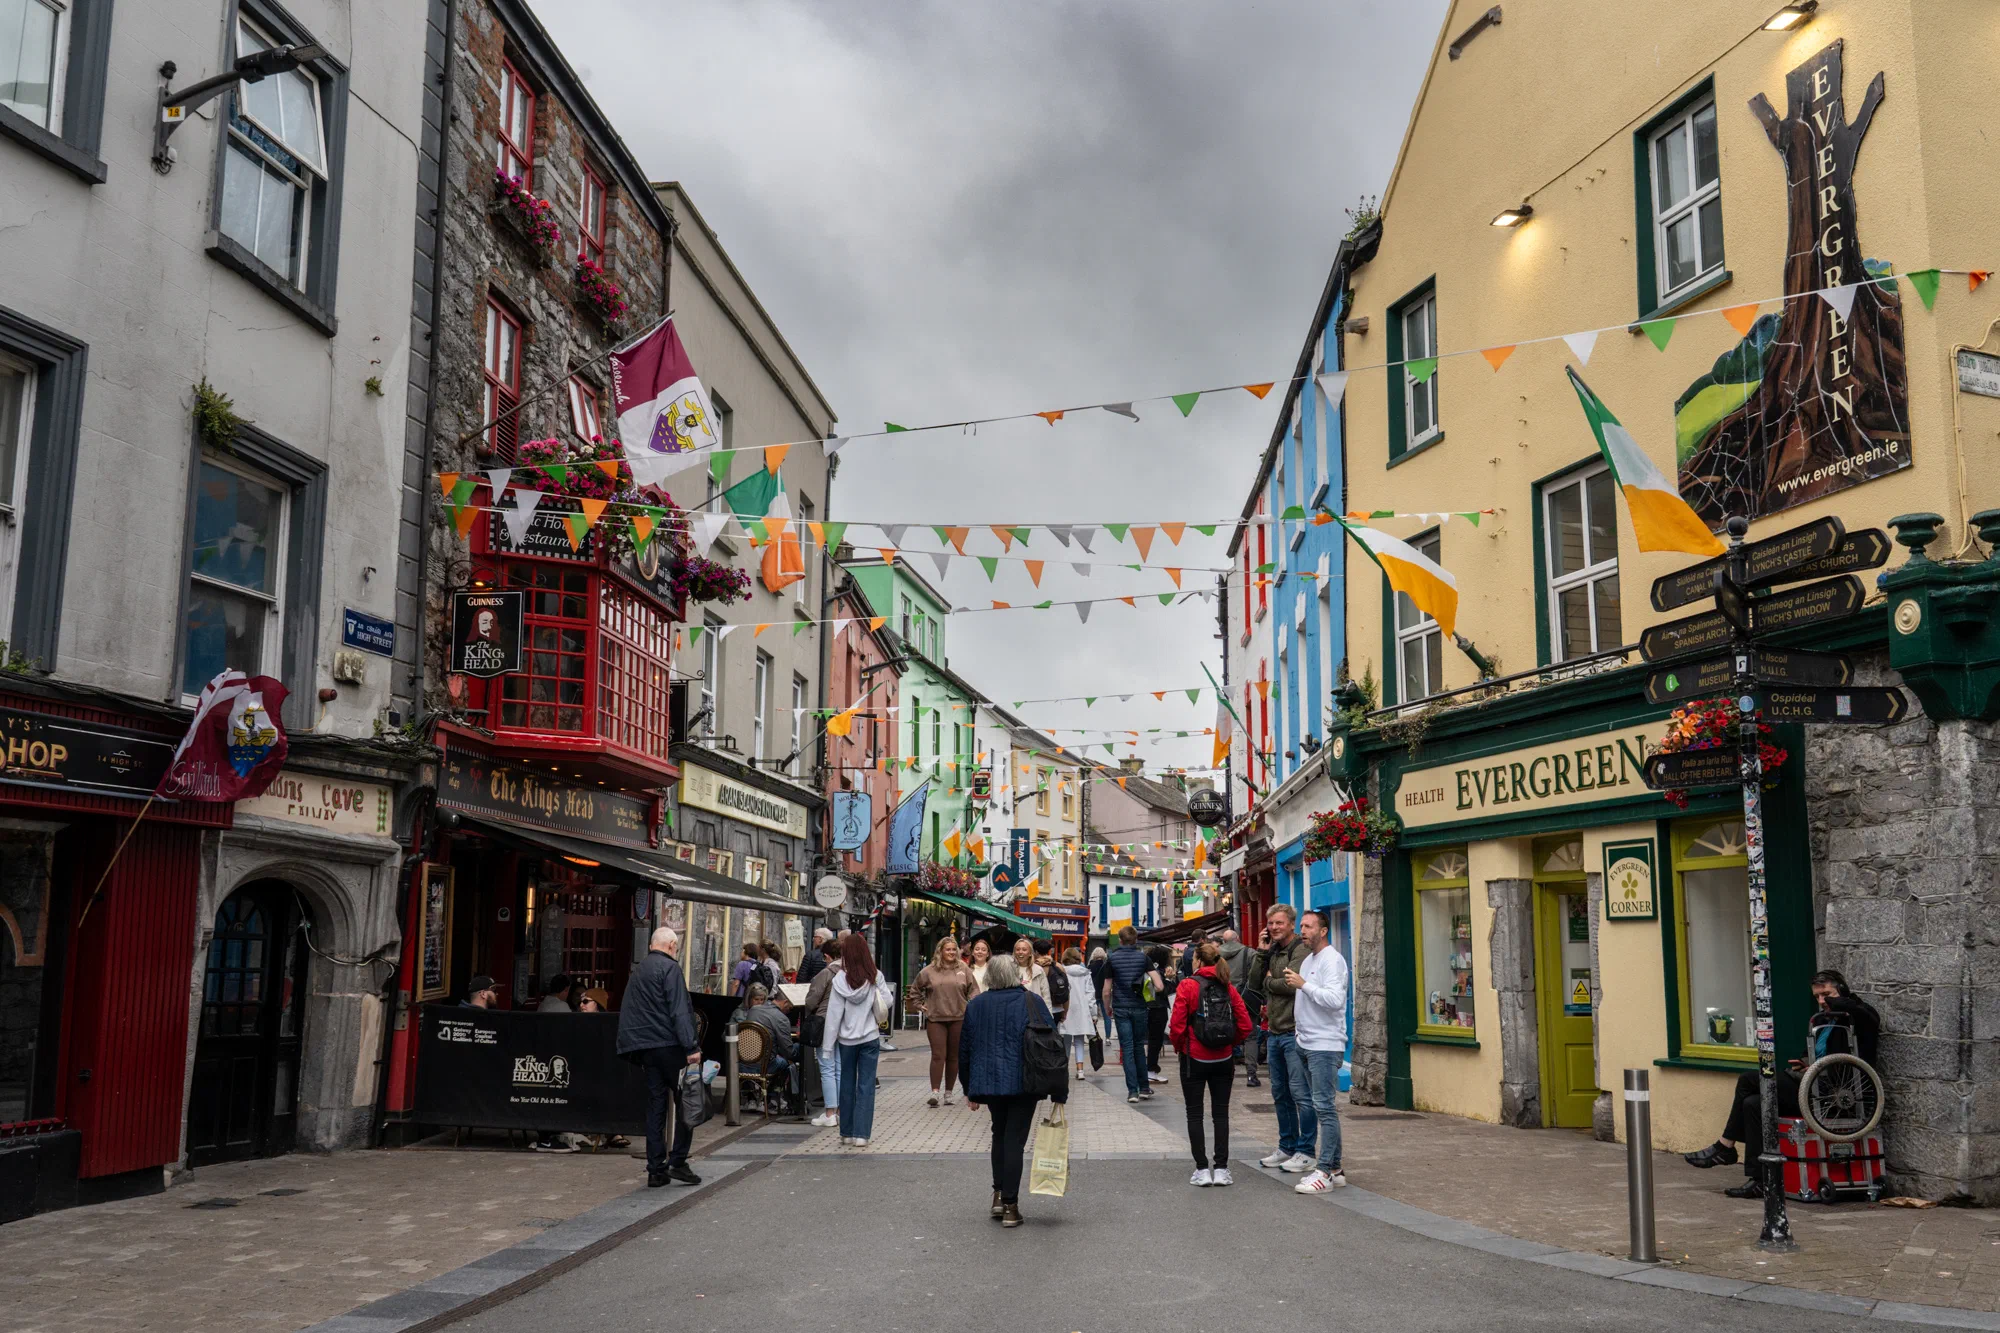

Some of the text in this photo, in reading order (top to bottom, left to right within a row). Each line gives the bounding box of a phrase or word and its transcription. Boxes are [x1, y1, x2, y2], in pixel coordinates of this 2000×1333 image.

[1777, 438, 1899, 495] www.evergreen.ie
[499, 528, 586, 550] & estaurat
[1751, 531, 1817, 561] Caisleán an Linsigh
[1752, 557, 1782, 574] LYNCH'S
[1783, 546, 1812, 563] CASTLE
[1820, 553, 1858, 569] CHURCH
[1686, 584, 1706, 596] CANAL
[467, 597, 504, 606] GUINNESS
[1757, 598, 1793, 613] Fuinneog
[1795, 595, 1805, 604] an
[1806, 587, 1837, 602] Linsigh
[1793, 602, 1831, 618] WINDOW
[357, 631, 393, 649] HIGH STREET
[476, 641, 490, 649] The
[1674, 627, 1727, 649] SPANISH ARCH
[463, 659, 502, 670] HEAD
[1701, 660, 1729, 674] Músaem
[1698, 673, 1730, 687] MUSEUM
[1770, 693, 1816, 704] Ospidéal
[1771, 706, 1815, 716] U.C.H.G.
[110, 756, 130, 765] HIGH
[1405, 734, 1647, 811] HEALTH EVERGREEN
[1663, 767, 1734, 782] HALL OF THE RED EARL
[322, 784, 364, 813] Cave
[490, 769, 594, 821] The Kings Head
[718, 783, 738, 810] ARAN
[1190, 801, 1223, 810] GUINNESS
[888, 863, 913, 872] MUSIC
[1609, 862, 1650, 881] EVERGREEN
[1610, 900, 1652, 914] CORNER
[512, 1071, 546, 1083] HEAD
